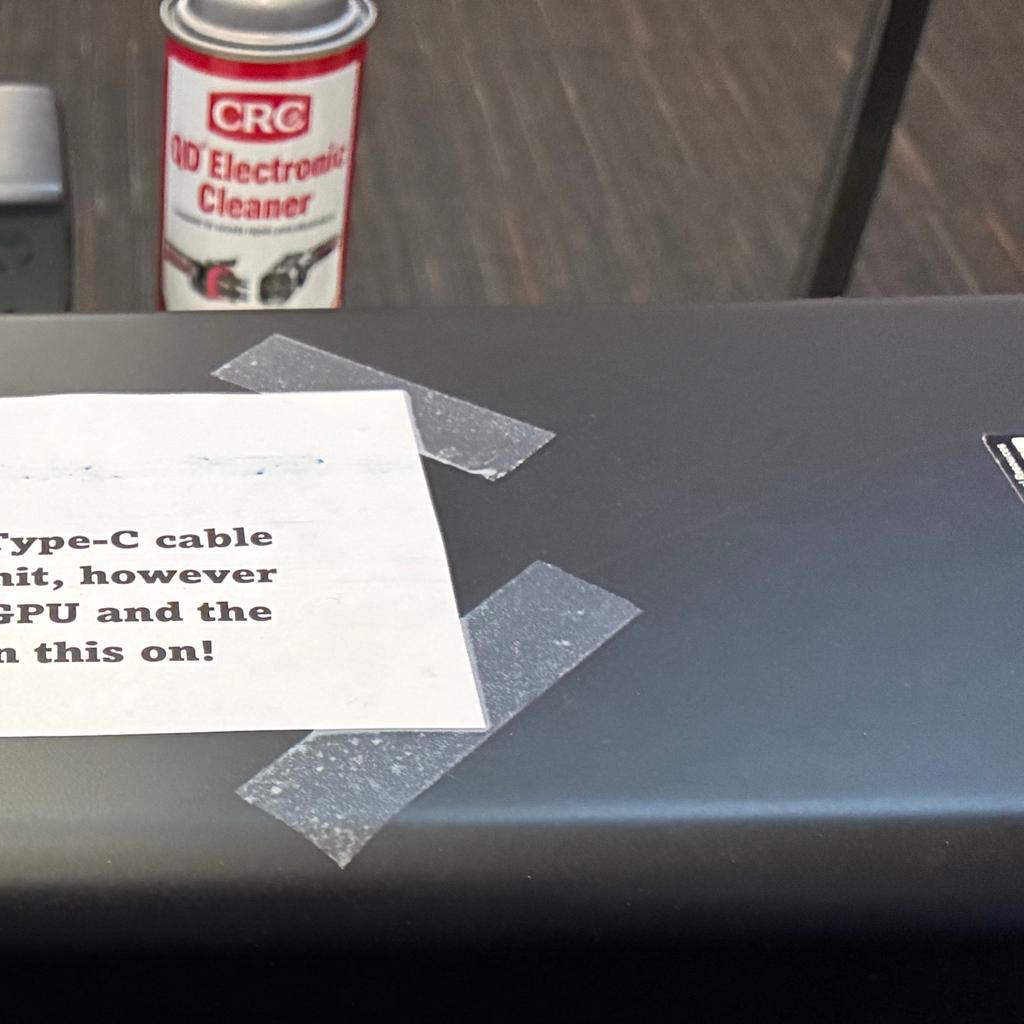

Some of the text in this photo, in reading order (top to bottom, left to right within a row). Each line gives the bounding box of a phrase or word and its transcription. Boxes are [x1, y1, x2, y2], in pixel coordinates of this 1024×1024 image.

[213, 101, 306, 133] CRC
[209, 143, 345, 184] Electronic
[199, 184, 312, 219] Cleaner
[156, 527, 272, 548] cable
[80, 566, 276, 585] however
[97, 602, 183, 622] and
[197, 602, 271, 621] the
[35, 641, 123, 663] this
[141, 641, 213, 662] on!
